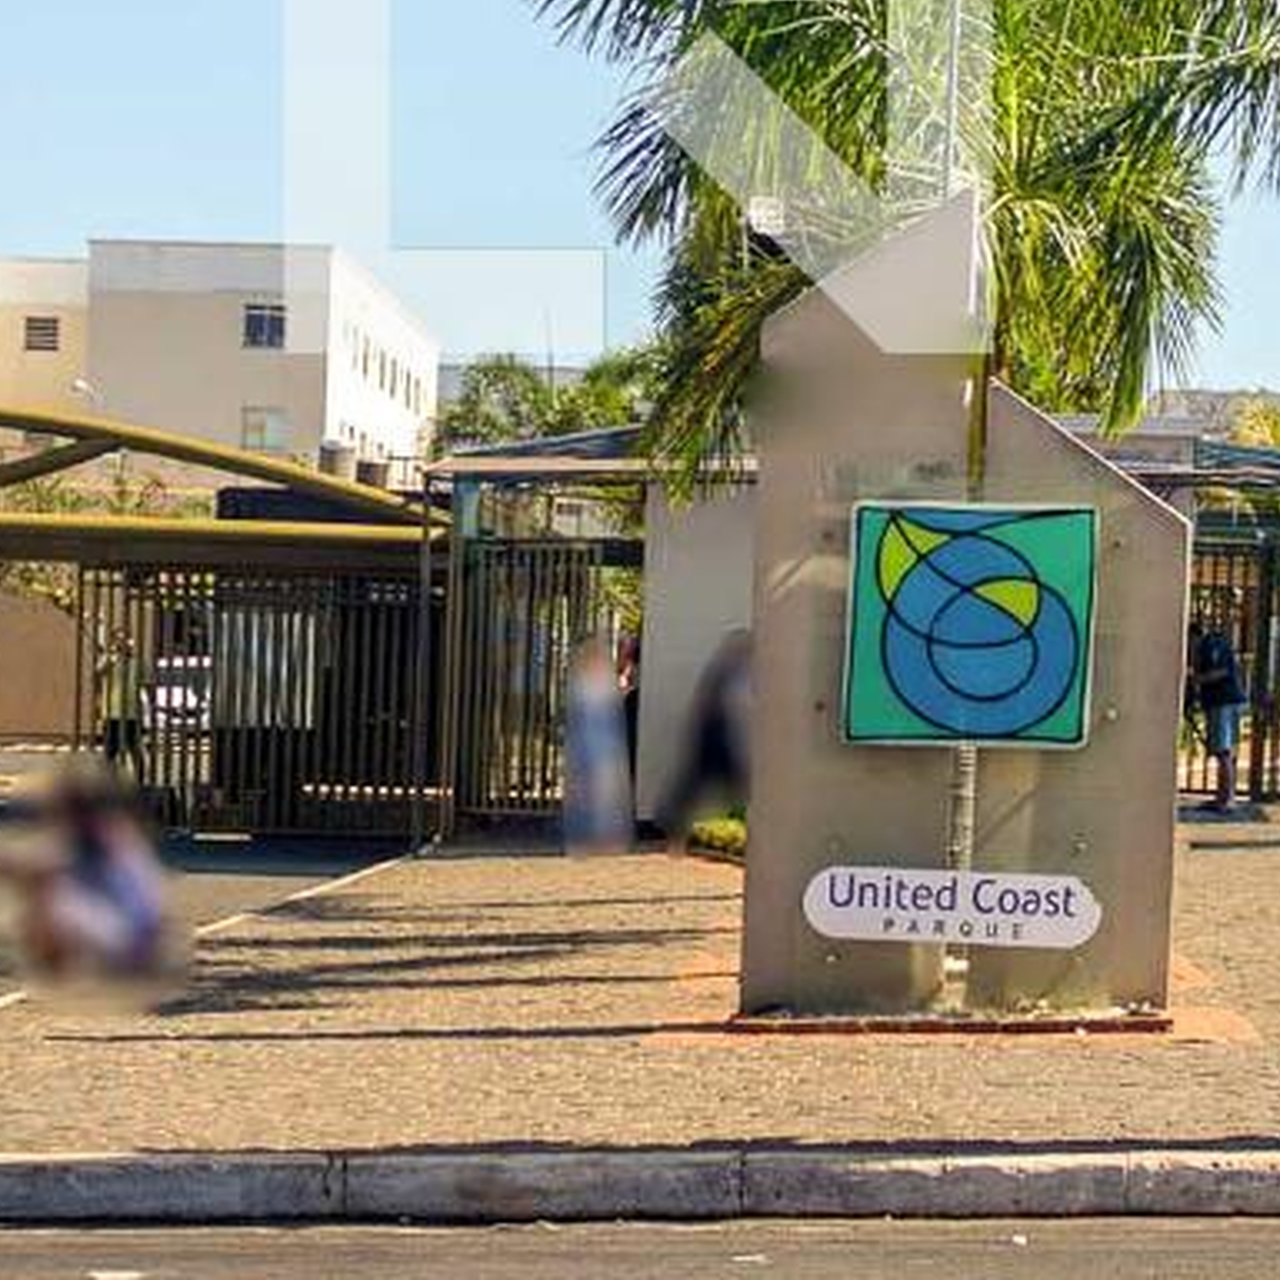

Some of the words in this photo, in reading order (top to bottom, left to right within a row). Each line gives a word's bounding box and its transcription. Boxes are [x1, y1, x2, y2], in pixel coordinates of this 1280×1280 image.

[828, 874, 958, 911] United
[972, 879, 1077, 917] Coast
[883, 919, 1023, 939] PARQUE
